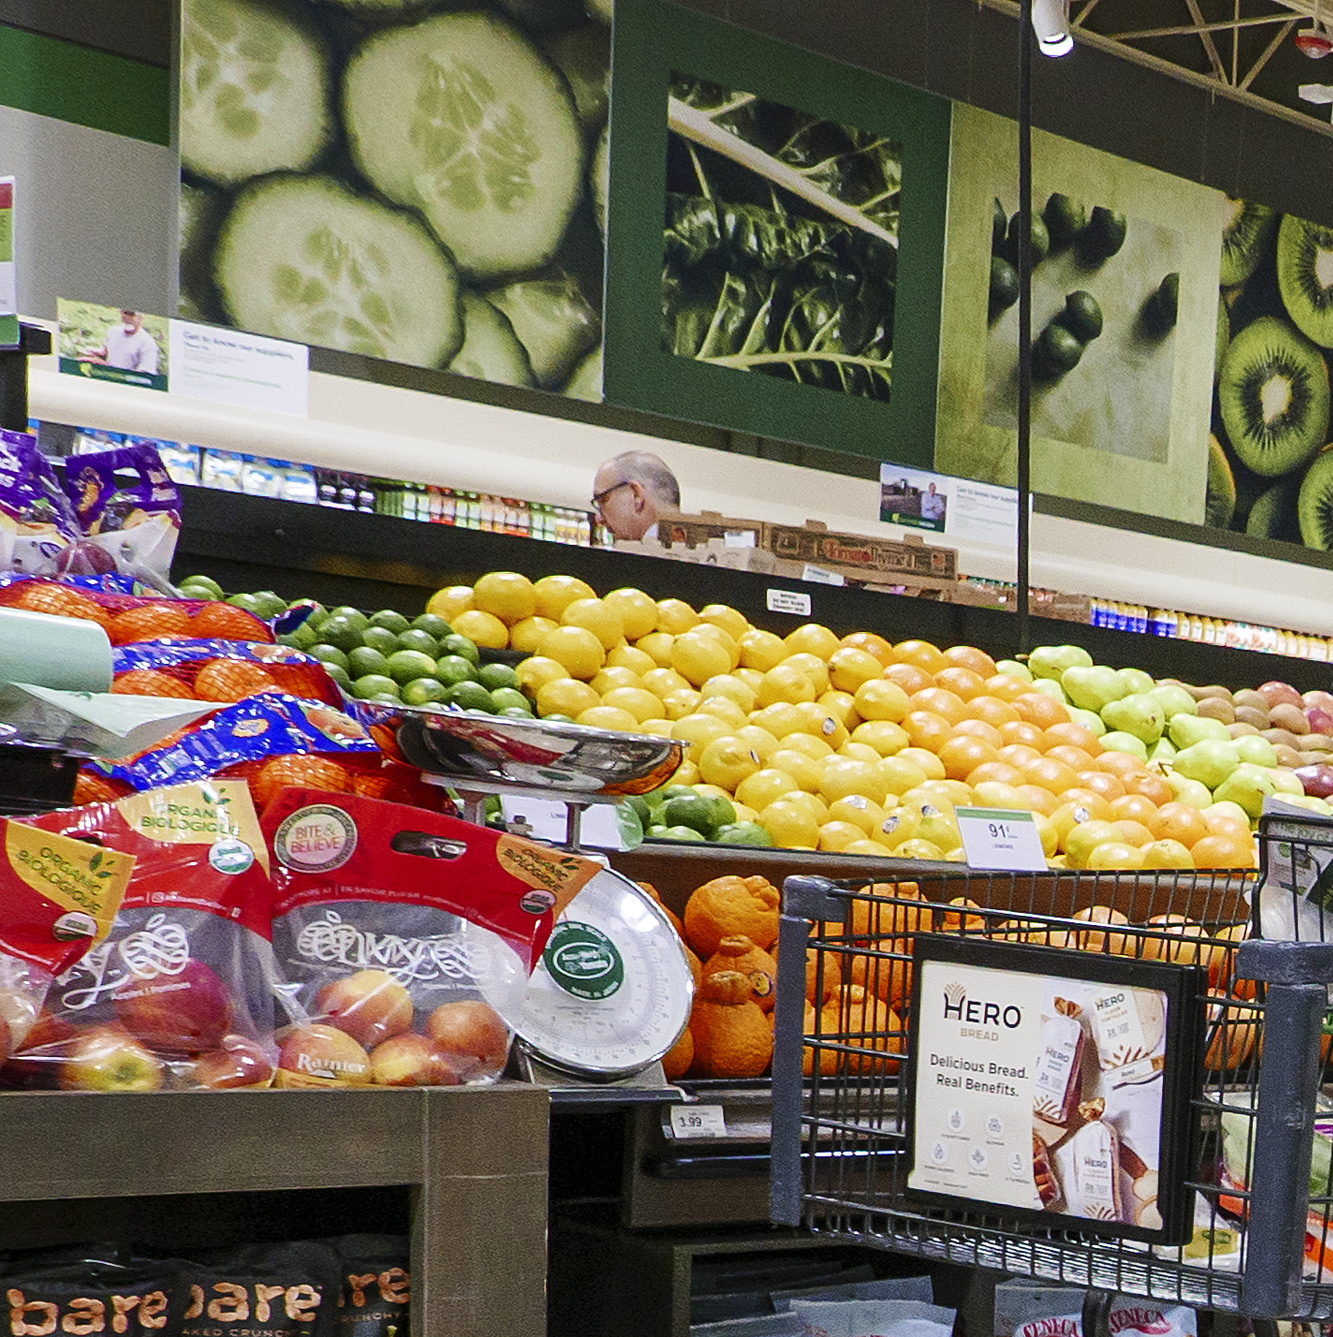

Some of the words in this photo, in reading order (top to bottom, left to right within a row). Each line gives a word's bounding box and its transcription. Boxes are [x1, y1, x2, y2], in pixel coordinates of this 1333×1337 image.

[290, 836, 342, 854] BELIEVE
[295, 826, 323, 841] BITE
[40, 846, 103, 897] ORGANIC
[503, 848, 564, 893] BIOLOGIQUE
[520, 848, 569, 882] ORGANIC
[17, 849, 103, 915] BIOLOGIQUE
[943, 990, 1022, 1029] HERO
[1094, 992, 1126, 1011] HERO
[960, 1027, 999, 1042] BREAD
[298, 1052, 366, 1075] Rainier
[930, 1053, 985, 1074] Delicious
[988, 1062, 1029, 1080] Bread.
[936, 1073, 963, 1089] Real
[965, 1079, 1020, 1098] Benefits.
[681, 1116, 702, 1128] 3.99
[348, 1267, 411, 1308] re
[7, 1288, 169, 1337] bare
[1108, 1307, 1167, 1334] SENECA
[182, 1328, 222, 1337] AKED
